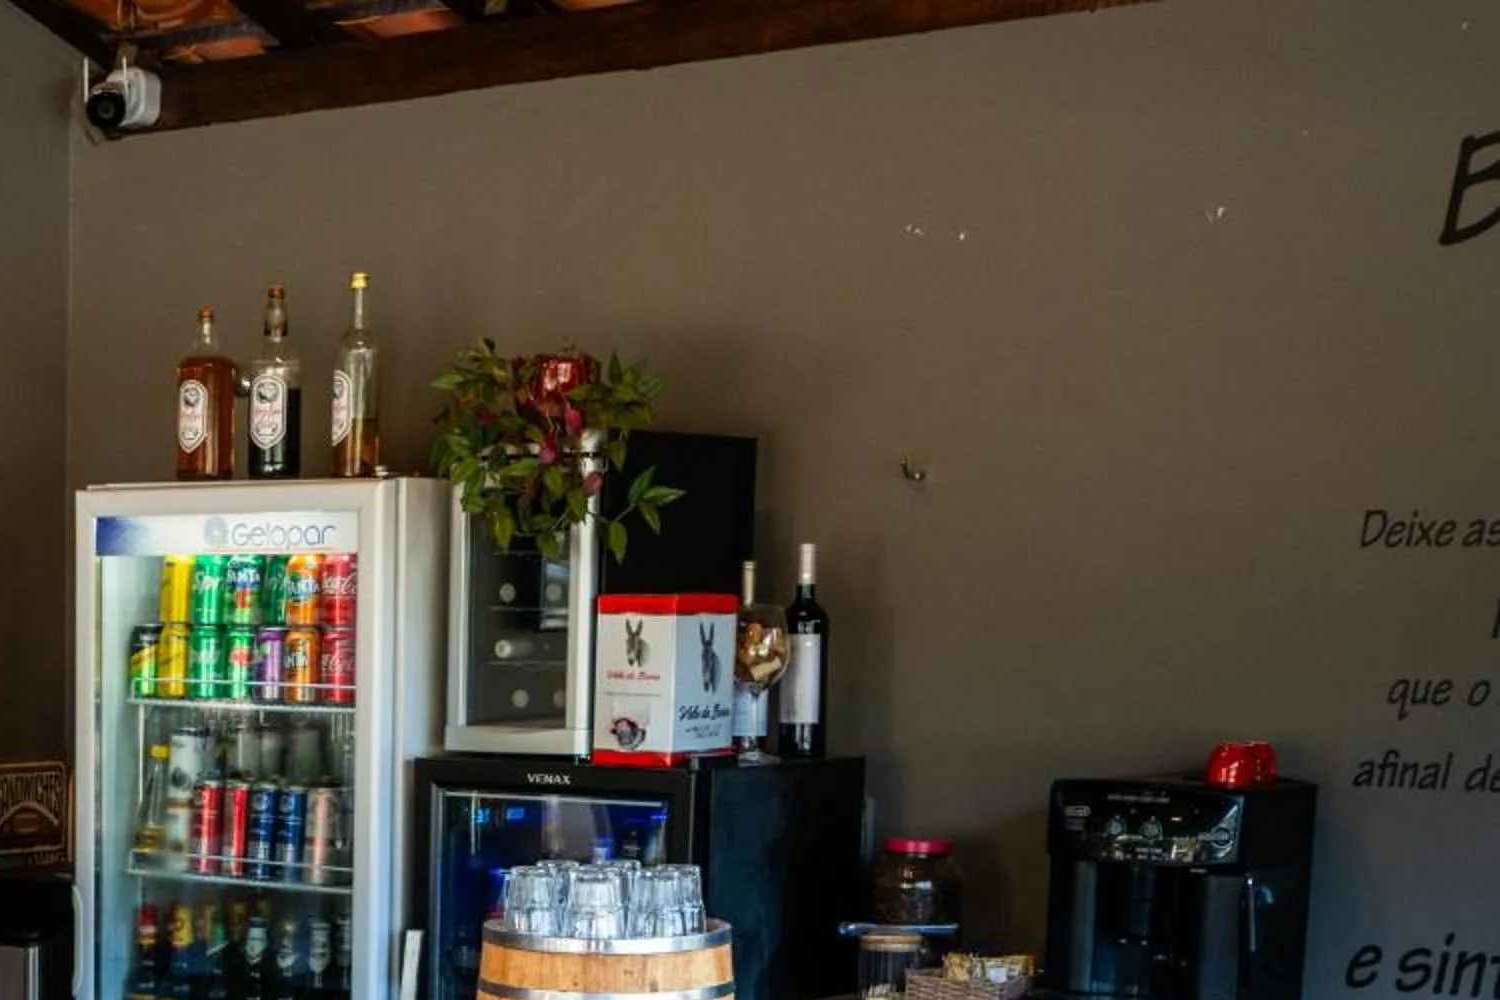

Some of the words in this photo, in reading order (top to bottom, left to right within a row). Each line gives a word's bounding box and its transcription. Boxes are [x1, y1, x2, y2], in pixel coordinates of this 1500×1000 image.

[231, 522, 337, 549] Gelopar
[1360, 509, 1457, 549] Deixe
[1386, 679, 1453, 721] que
[1467, 679, 1490, 708] o
[527, 773, 571, 786] VENAX
[1351, 748, 1453, 791] afinal
[1344, 944, 1384, 989] e
